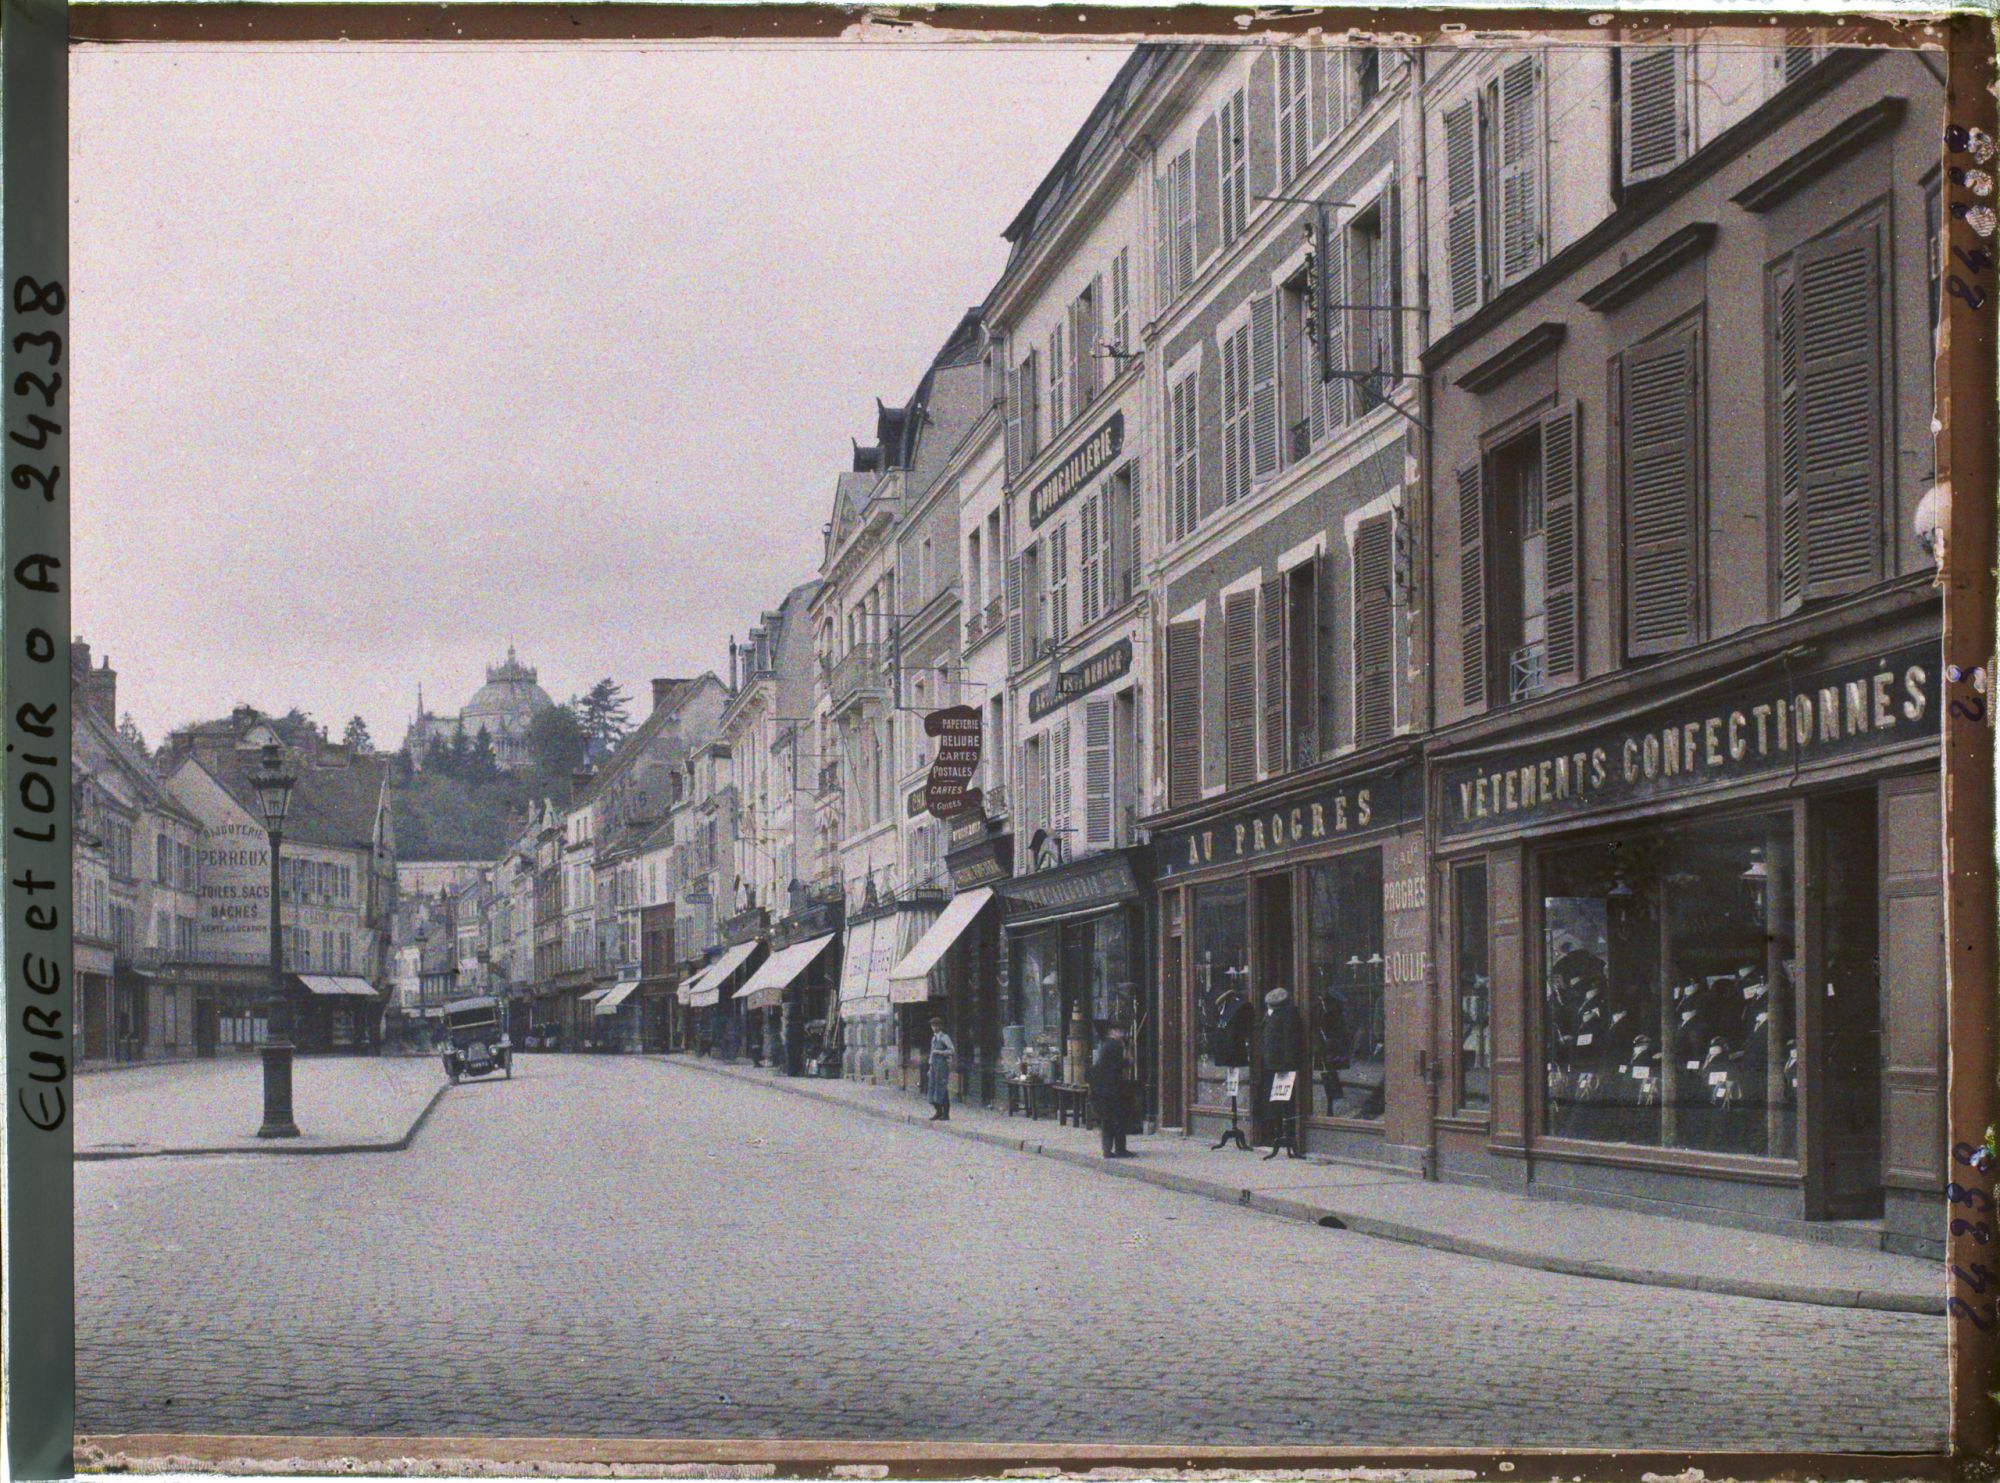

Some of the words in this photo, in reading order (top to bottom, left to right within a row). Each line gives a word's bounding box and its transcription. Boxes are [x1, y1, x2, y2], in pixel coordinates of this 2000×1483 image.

[9, 274, 66, 502] 24238
[1036, 426, 1112, 517] QUINCAILLERIE
[13, 552, 61, 593] A
[942, 718, 979, 730] PAPETERIE
[1621, 659, 1927, 784] CONFECTIONNÉS
[939, 751, 977, 762] CARTES
[942, 734, 980, 747] RELIURE
[930, 785, 963, 795] CARTES
[932, 766, 972, 779] POSTALES
[1187, 830, 1213, 865] AU
[12, 869, 58, 931] et
[242, 886, 270, 898] SACS
[19, 953, 67, 1131] EURE
